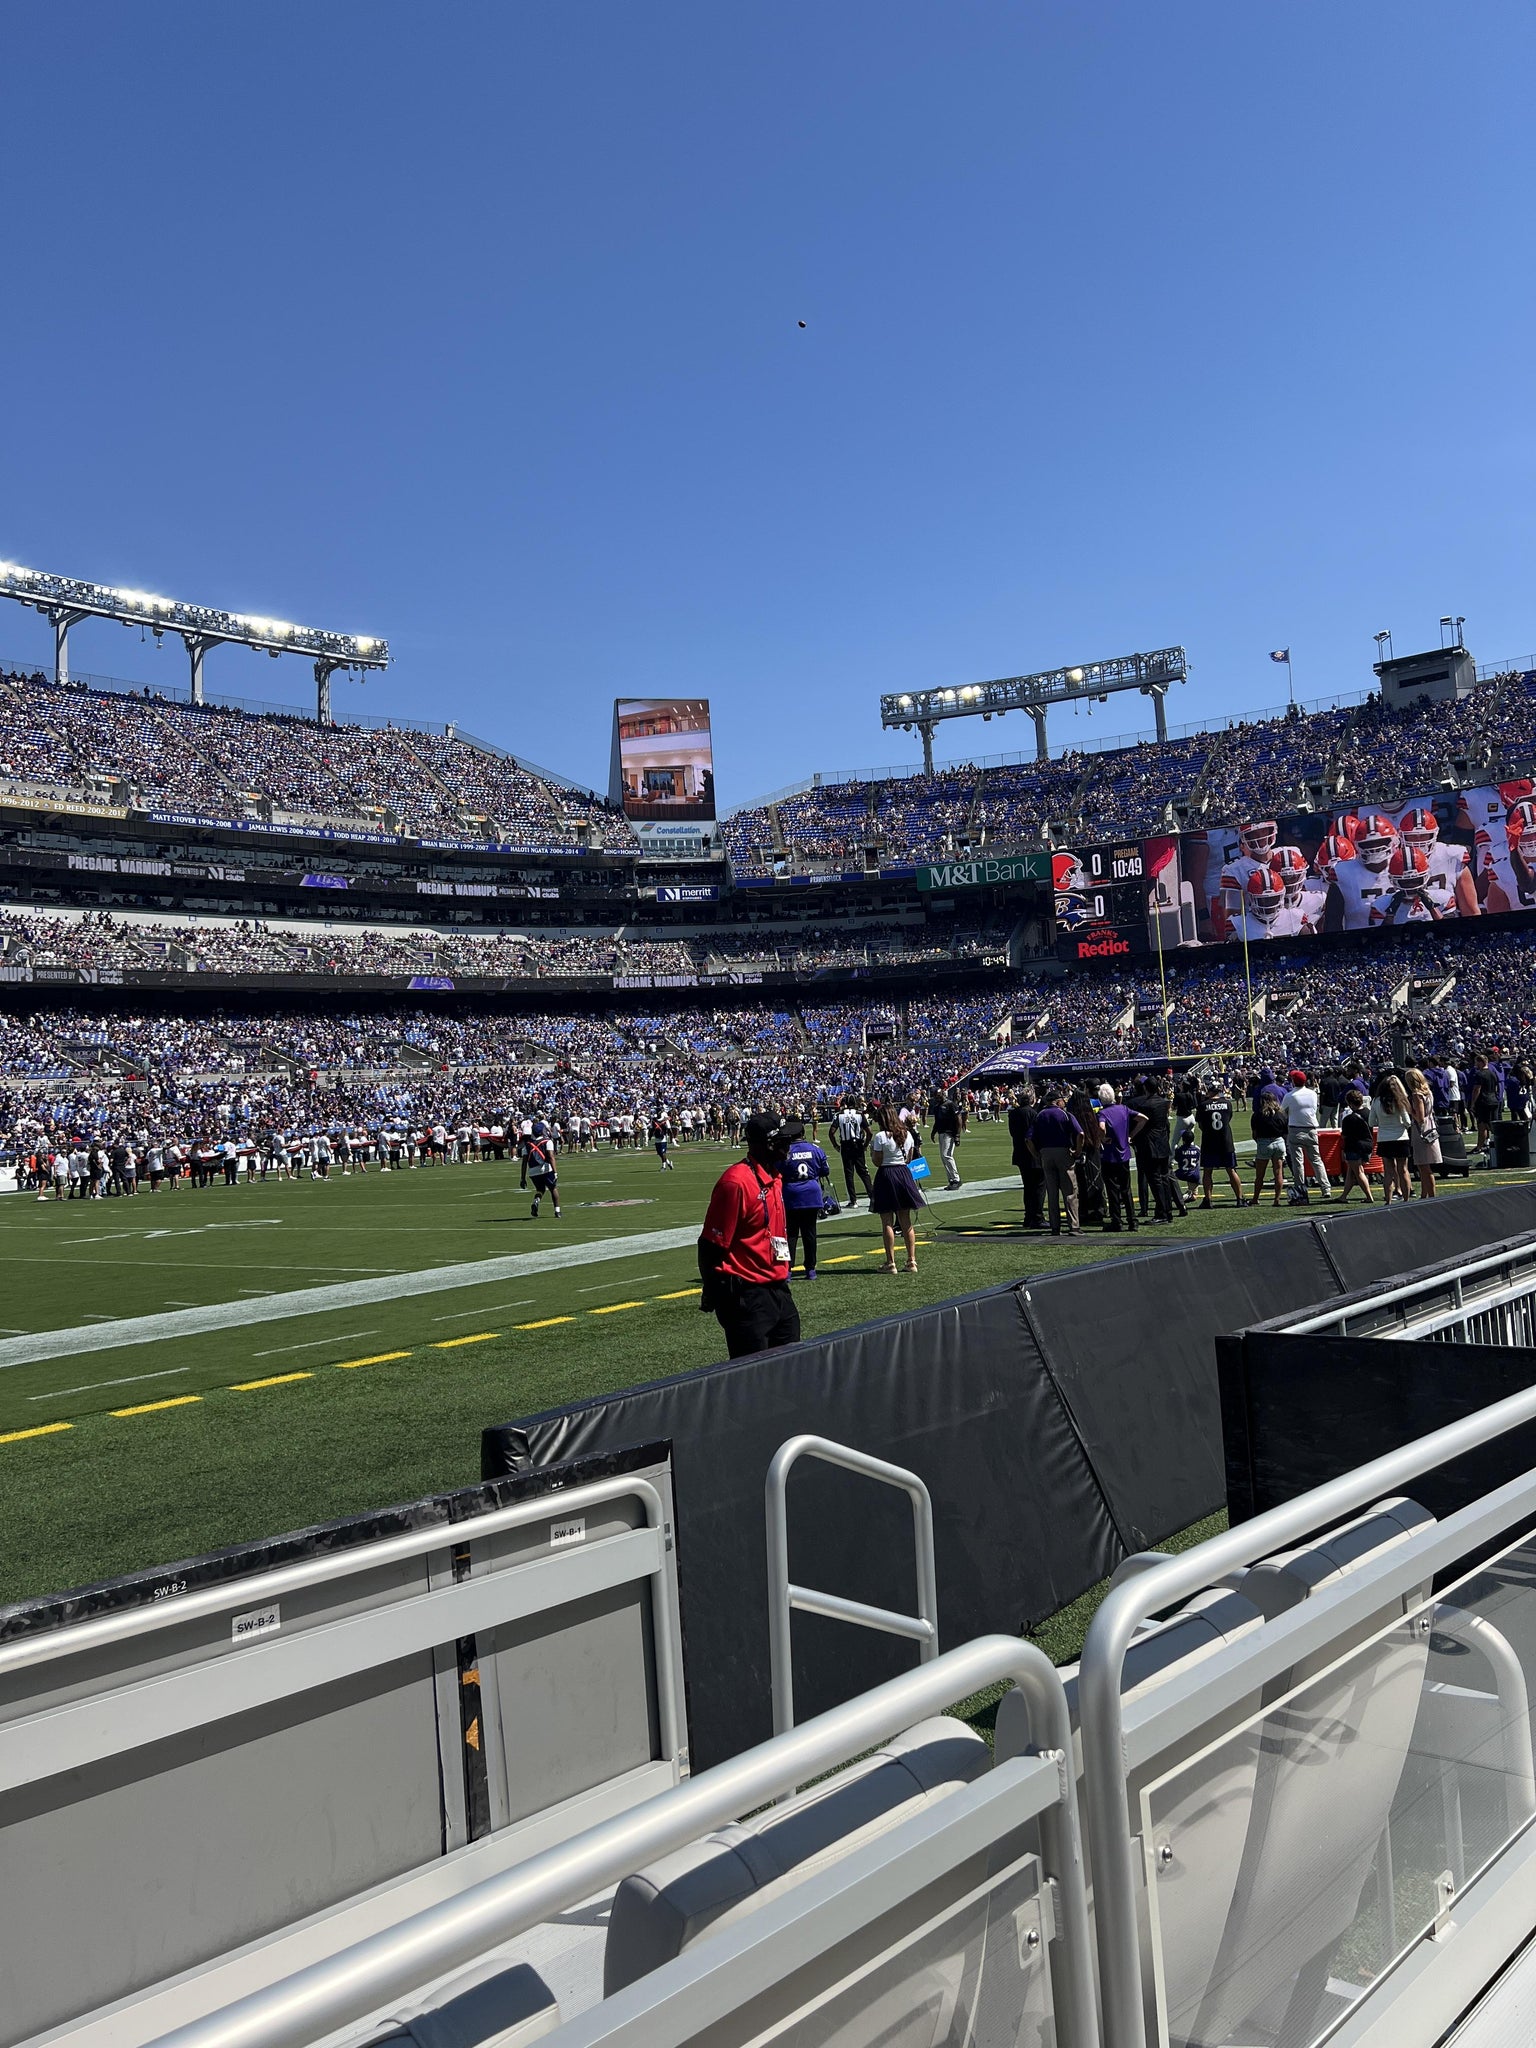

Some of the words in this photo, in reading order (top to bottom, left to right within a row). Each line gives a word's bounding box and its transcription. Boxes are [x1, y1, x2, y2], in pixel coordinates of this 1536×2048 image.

[66, 803, 85, 813] REED
[87, 807, 126, 817] 2002-2012
[153, 813, 171, 821] MATT
[172, 816, 196, 824] STOVER
[198, 819, 232, 828] 1996-2008
[248, 823, 268, 832] JAMAL
[269, 825, 288, 833] LEWIS
[289, 827, 320, 837] 2000-2006
[350, 833, 366, 841] HEAP
[367, 835, 397, 844] 2001-2010
[460, 843, 489, 851] 1999-2007
[1113, 847, 1139, 859] PREGAME
[68, 855, 118, 872] PREGAME
[120, 859, 172, 876] WARMUPS
[1092, 853, 1102, 876] 0
[1112, 857, 1143, 879] 10:49
[225, 874, 246, 882] clubs
[929, 862, 984, 889] M&T
[985, 856, 1038, 882] Bank
[417, 882, 454, 896] PREGAME
[454, 884, 498, 897] WARMUPS
[682, 888, 712, 896] merritt
[1094, 895, 1105, 917] 0
[1086, 929, 1119, 941] FRANK'S
[1077, 940, 1130, 958] RedHot
[982, 955, 1005, 967] 10:49
[36, 970, 67, 980] PRESENTED
[68, 971, 76, 980] BY
[99, 976, 124, 984] clubs
[613, 976, 653, 988] PREGAME
[653, 975, 698, 987] WARMUPS
[1205, 1103, 1228, 1111] JACKSON
[1211, 1111, 1223, 1131] 8
[792, 1151, 813, 1161] JACKSON
[797, 1163, 808, 1179] 8
[1182, 1158, 1197, 1171] 25
[554, 1526, 581, 1539] SW-B-1
[154, 1580, 187, 1599] SW-B-2
[237, 1614, 275, 1633] SW-B-2
